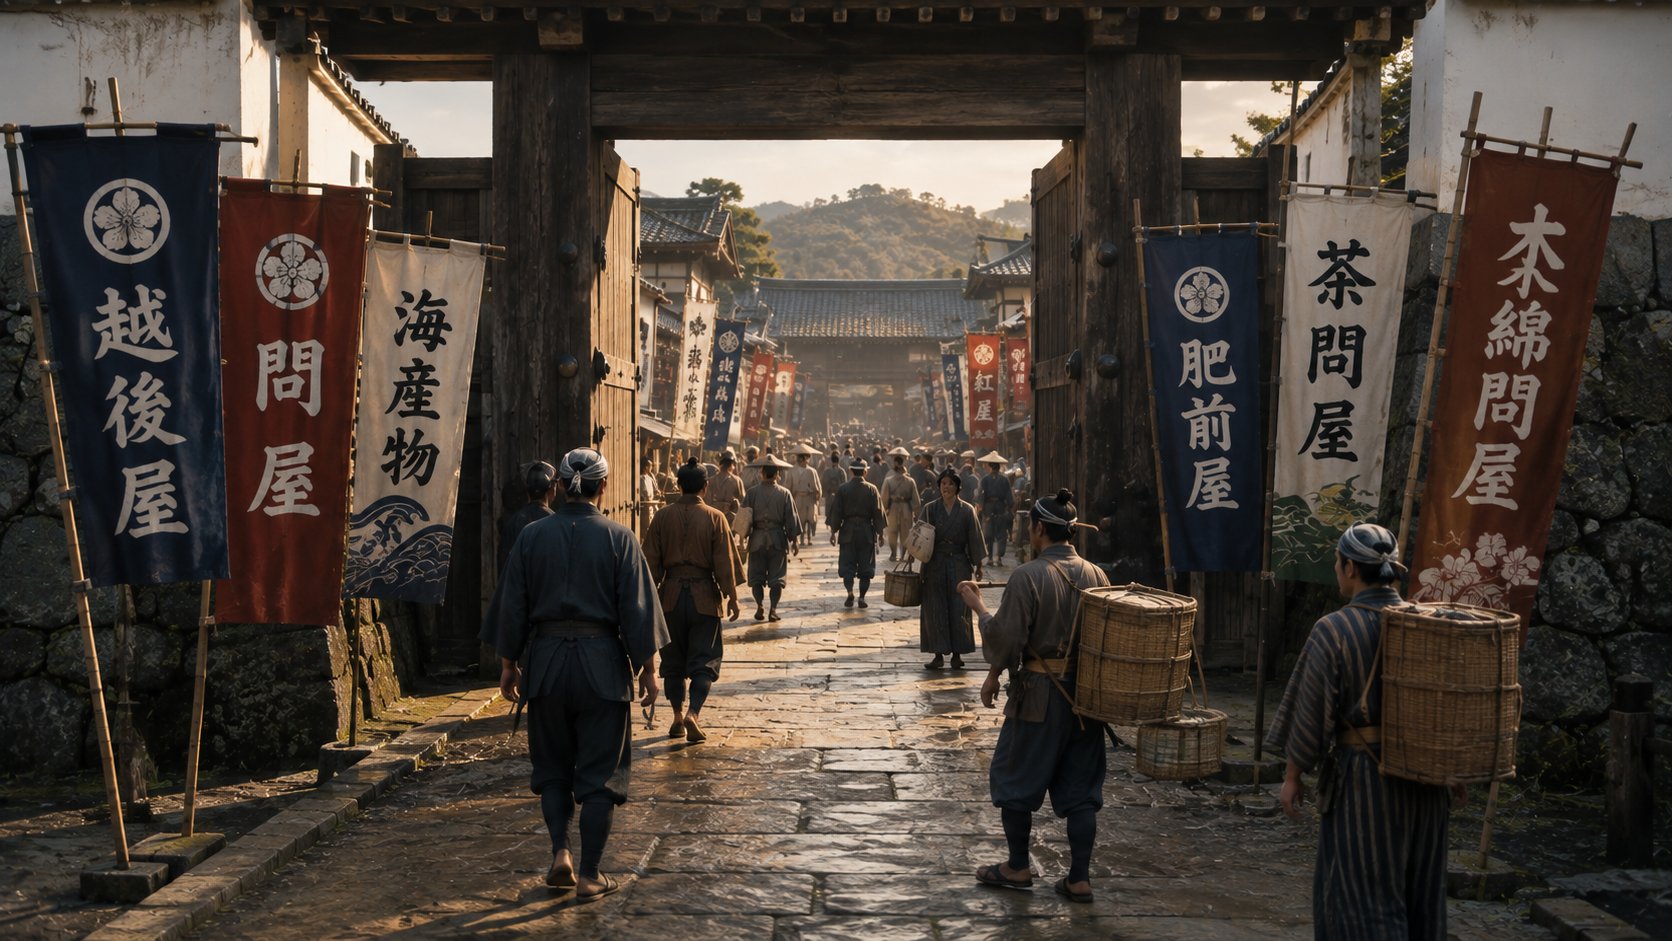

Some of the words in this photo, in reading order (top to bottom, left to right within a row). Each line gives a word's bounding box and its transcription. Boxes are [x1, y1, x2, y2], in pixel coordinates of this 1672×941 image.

[92, 284, 189, 539] 越後屋
[247, 339, 325, 517] 問屋
[381, 289, 452, 487] 海産物
[1178, 338, 1240, 511] 肥前屋
[1298, 239, 1376, 462] 茶問屋
